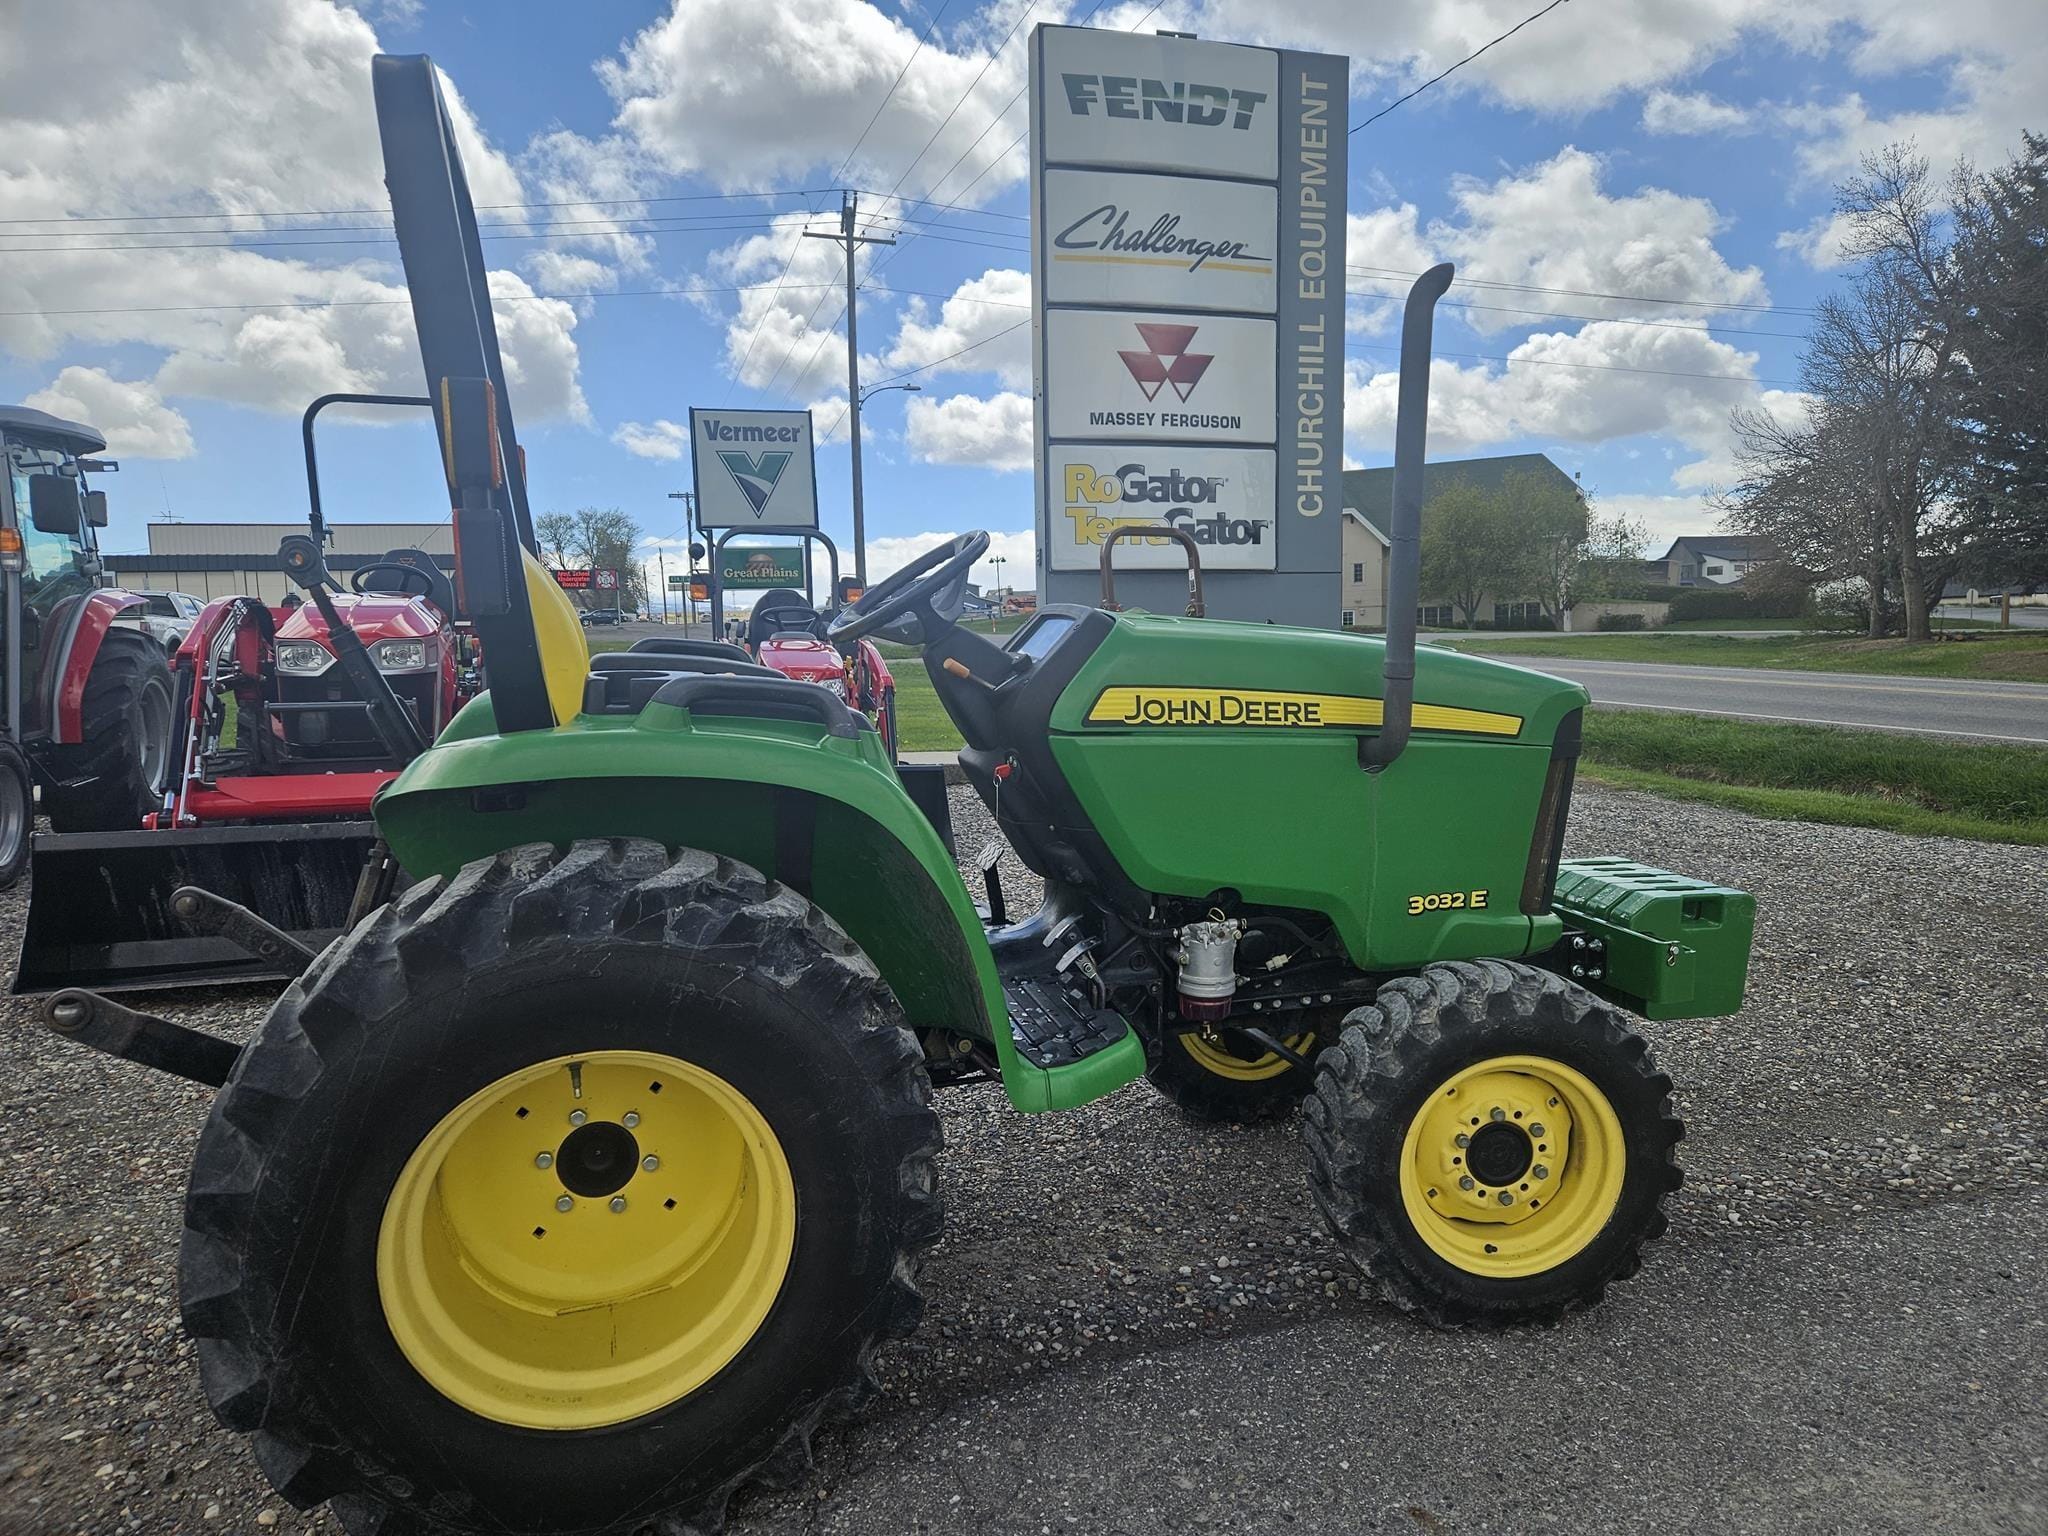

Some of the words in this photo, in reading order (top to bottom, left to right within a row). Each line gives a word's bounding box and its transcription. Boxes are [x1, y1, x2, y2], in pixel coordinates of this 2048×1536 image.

[1061, 73, 1268, 131] FENDT
[1299, 72, 1329, 300] EQUIPMENT
[1053, 204, 1273, 273] Challenger
[703, 419, 801, 443] Vermeer
[1089, 411, 1156, 427] MASSEY
[1161, 413, 1242, 430] FERGUSON
[1297, 313, 1326, 517] CHURCHILL
[1064, 463, 1225, 503] RoGator
[723, 568, 759, 578] Great
[761, 567, 799, 578] Plains
[1124, 694, 1211, 723] JOHN
[1219, 695, 1322, 724] DEERE
[1407, 892, 1466, 915] 3032
[1470, 889, 1488, 909] E
